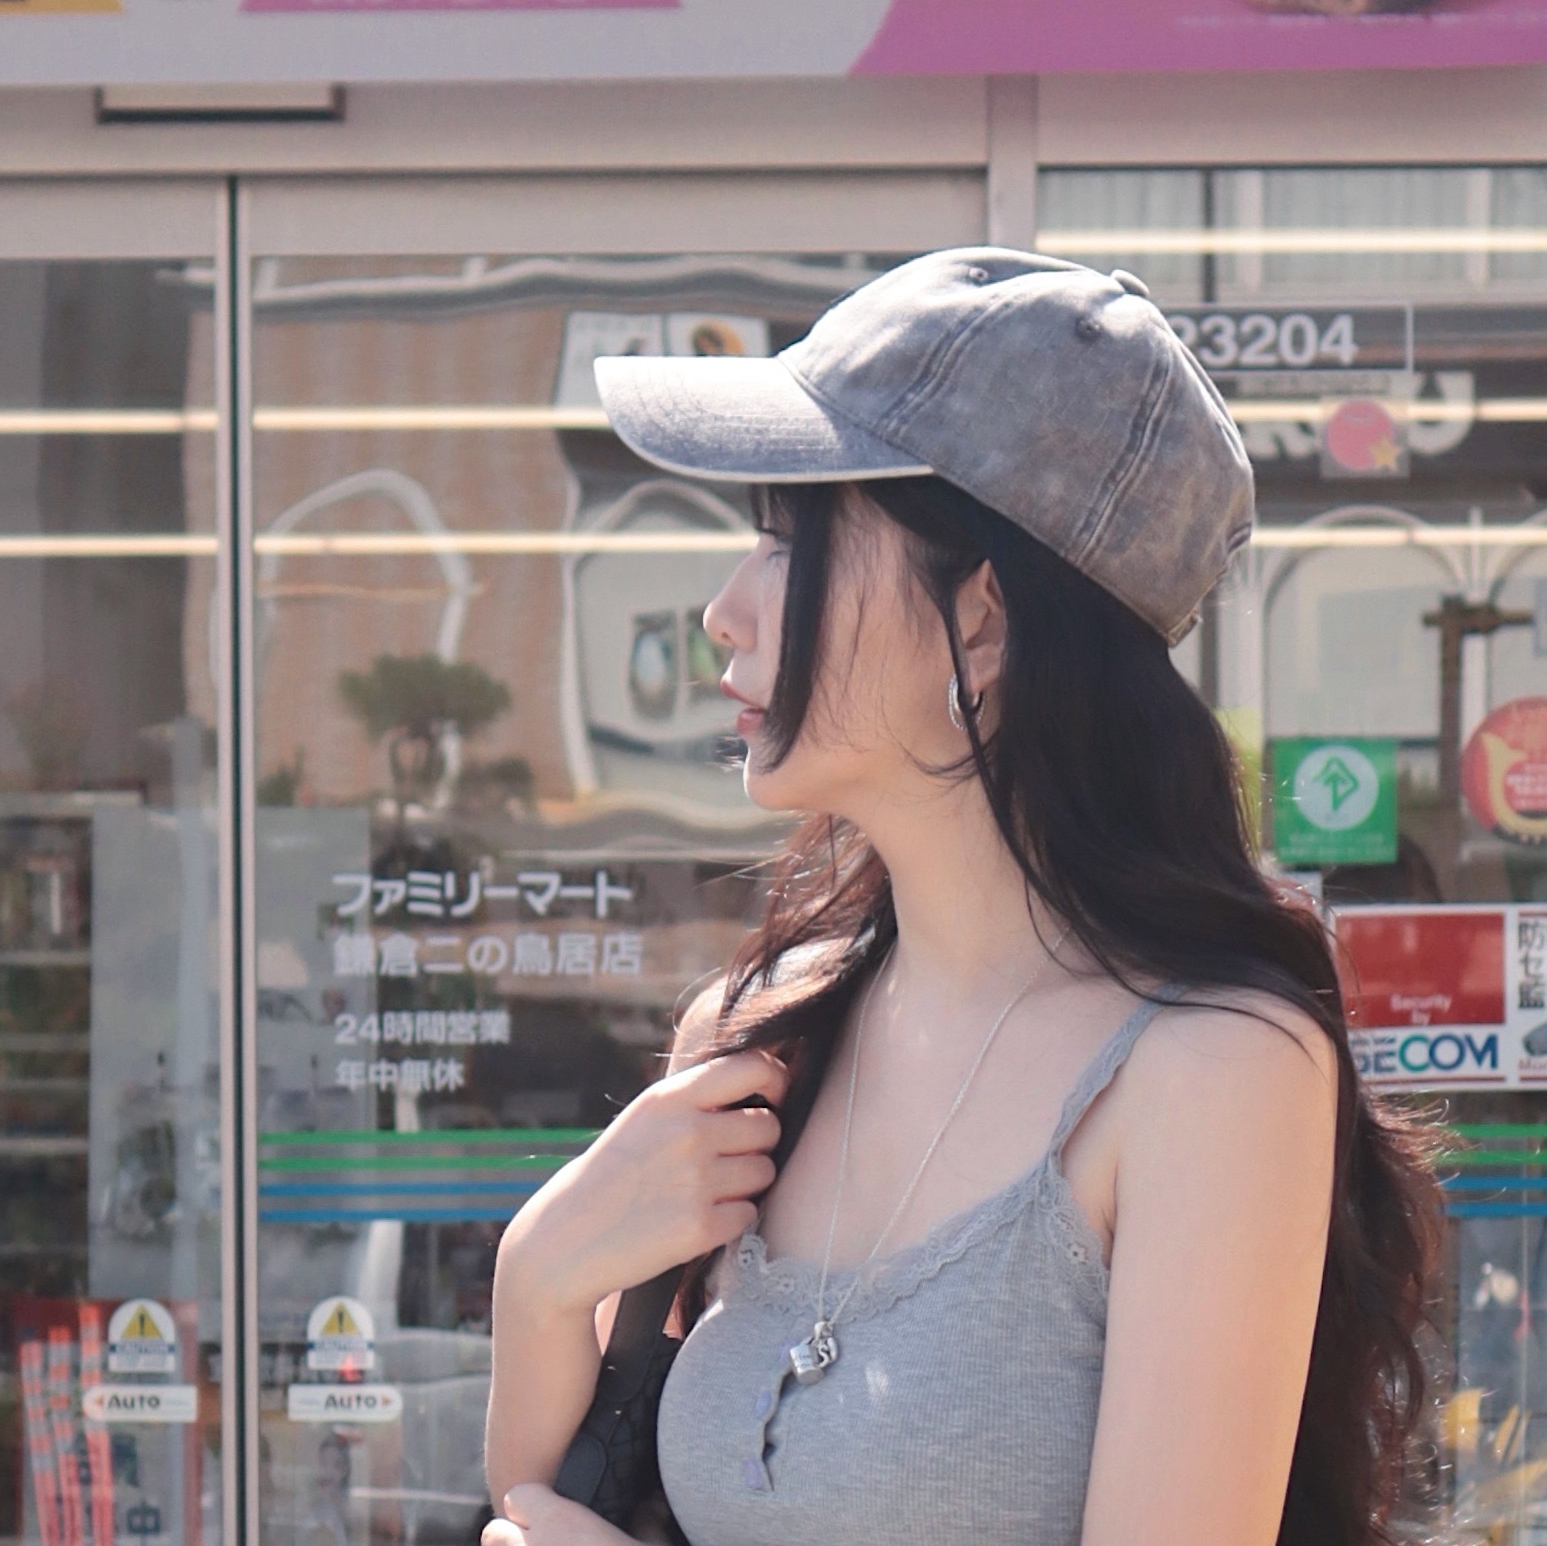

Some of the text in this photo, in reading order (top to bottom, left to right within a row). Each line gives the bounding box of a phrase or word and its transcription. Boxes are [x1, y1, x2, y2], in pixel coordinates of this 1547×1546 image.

[330, 870, 634, 920] ファミリーマート
[330, 930, 646, 978] 鎌倉二の鳥居店
[332, 1010, 512, 1046] 24時間営業
[334, 1062, 466, 1090] 年中無休
[107, 1393, 160, 1410] Auto
[324, 1392, 378, 1410] Auto
